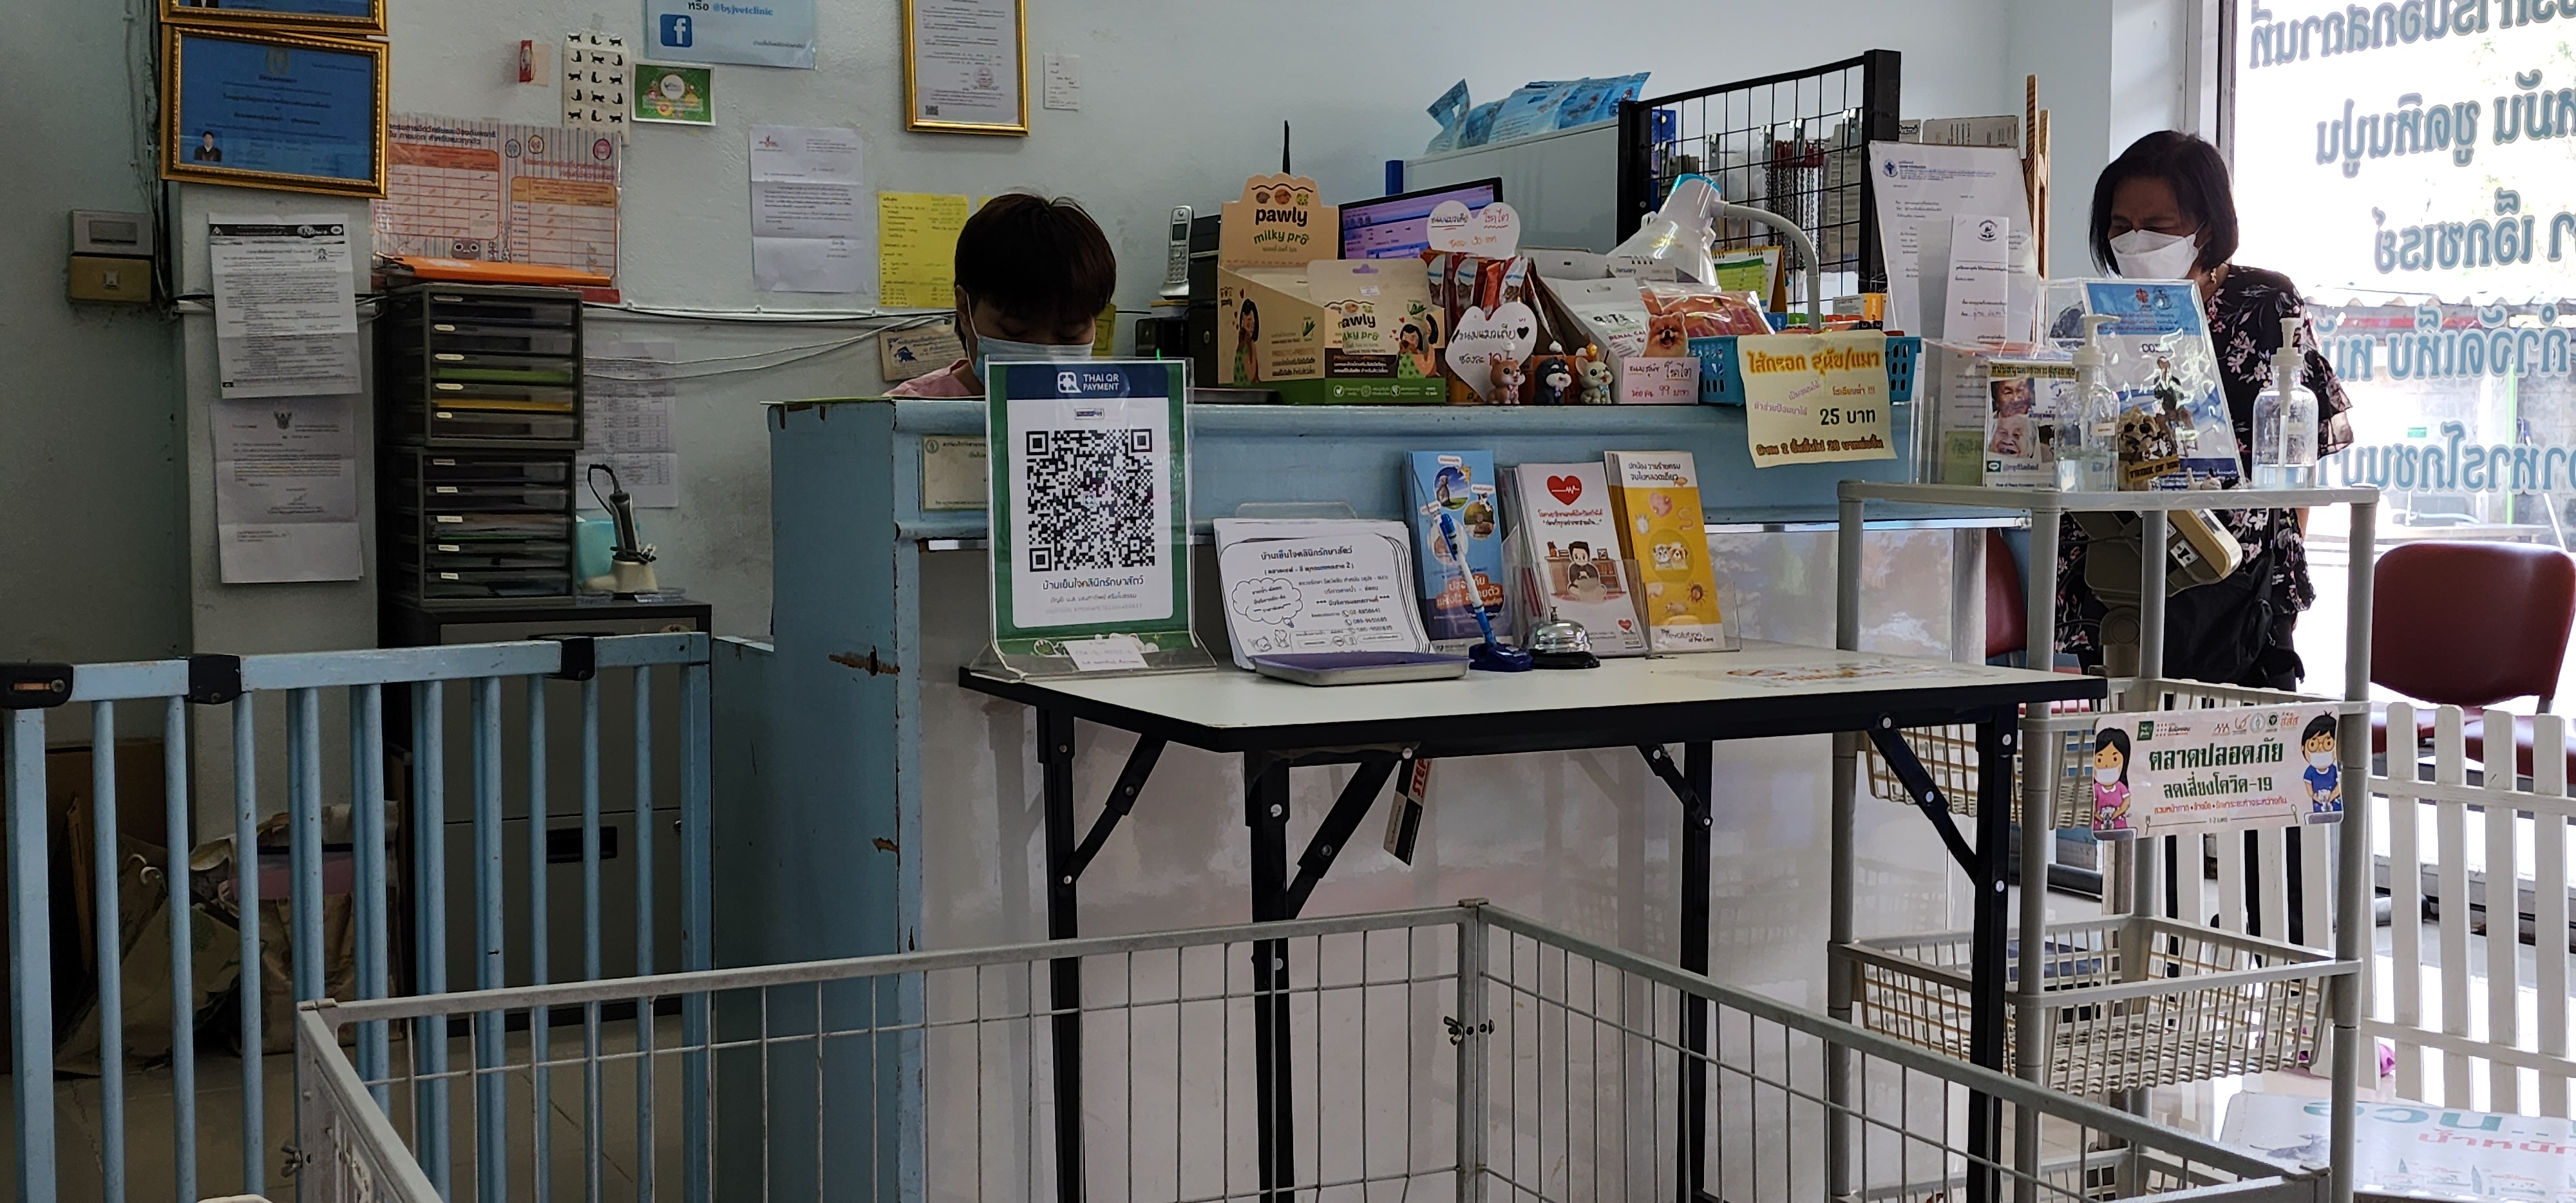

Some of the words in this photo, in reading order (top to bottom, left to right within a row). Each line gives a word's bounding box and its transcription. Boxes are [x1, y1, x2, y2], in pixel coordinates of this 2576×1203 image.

[1255, 206, 1308, 227] pawly
[1253, 229, 1285, 244] milky
[1341, 313, 1376, 328] awly
[1747, 350, 1806, 374] ไส้กรอก
[1812, 346, 1880, 376] สุนัข/แมว
[1083, 373, 1104, 383] THAI
[1106, 373, 1119, 383] QR
[1083, 383, 1119, 392] PAYMENT
[1819, 408, 1840, 426] 25
[1847, 408, 1876, 424] บาท
[1042, 574, 1145, 591] บ้านเย็นใจคลินิกรักษาสัตว์
[2148, 737, 2284, 772] ตลาดปลอดภัย
[2163, 771, 2273, 799] ลดเสี่ยงโควิด-19
